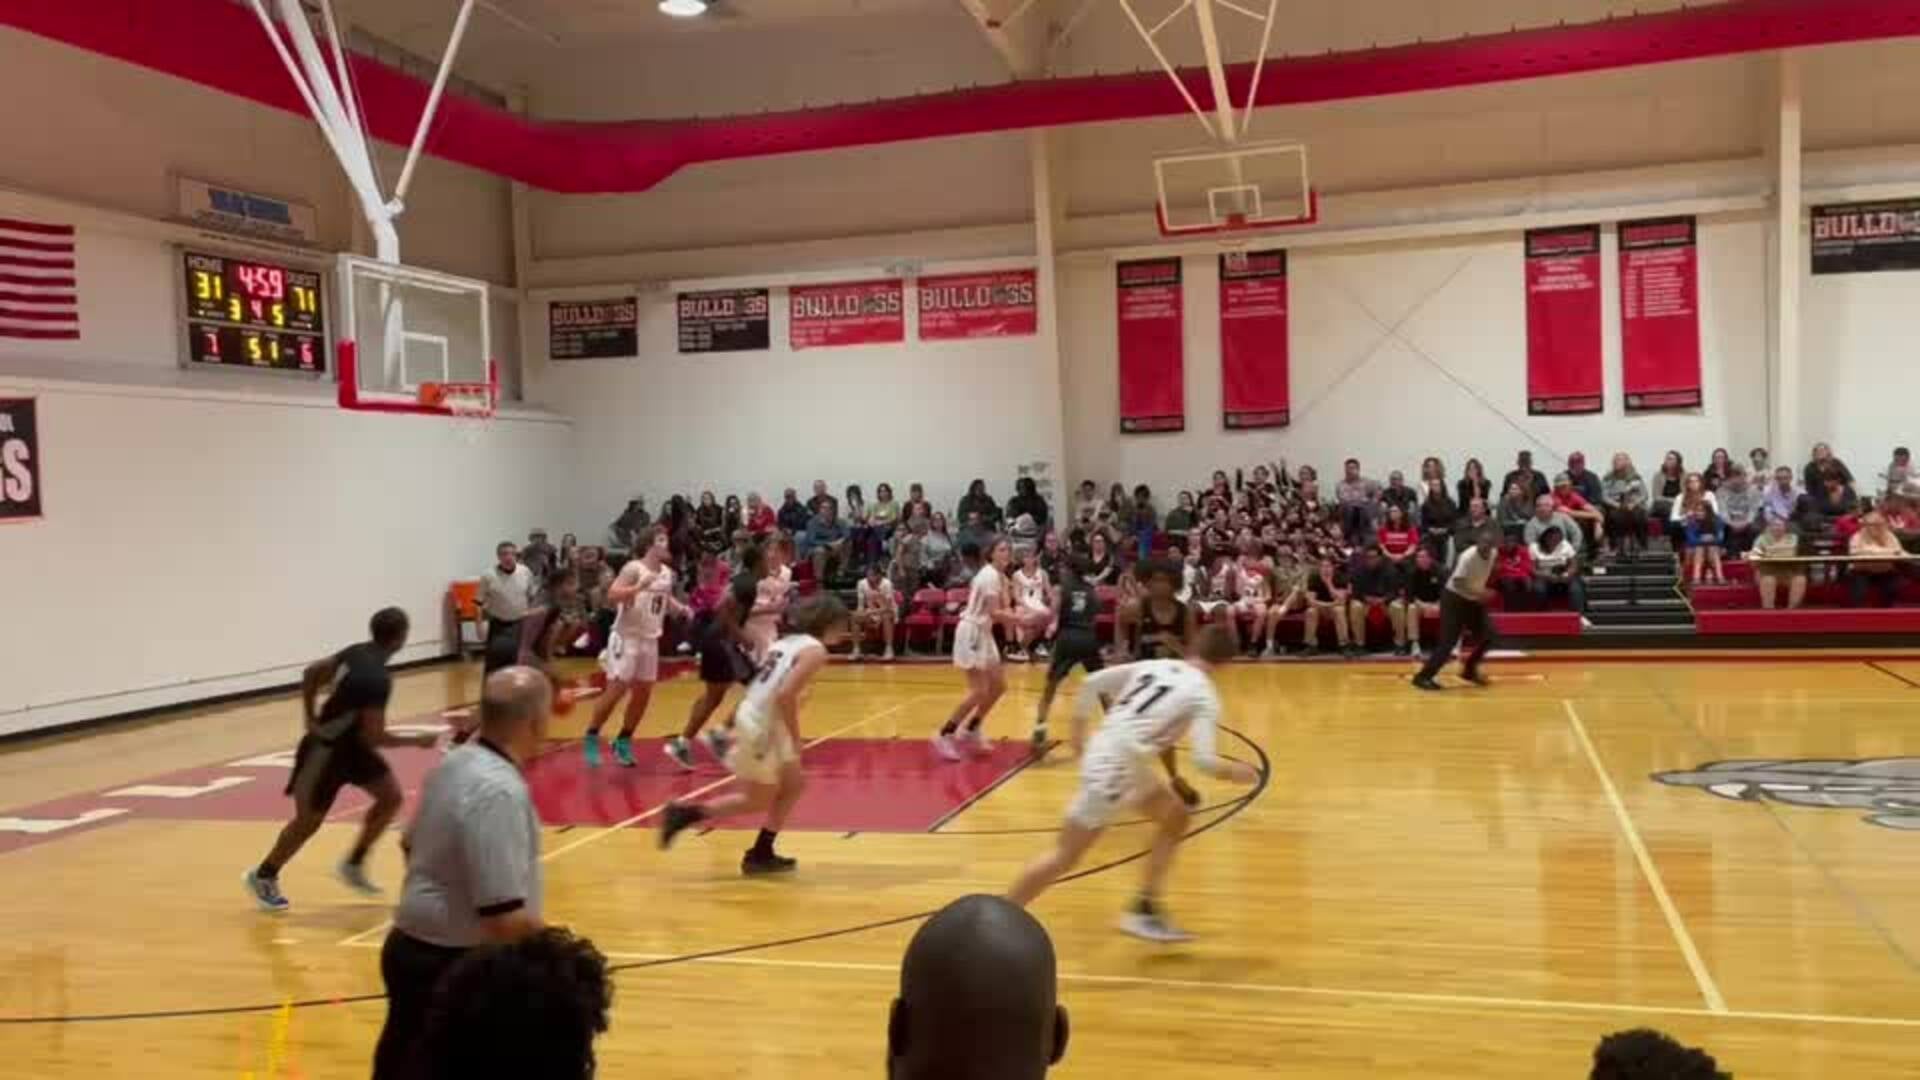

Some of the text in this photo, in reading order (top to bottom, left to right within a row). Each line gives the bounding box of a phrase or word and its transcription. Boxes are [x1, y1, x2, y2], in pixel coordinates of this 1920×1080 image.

[195, 272, 221, 299] 31
[229, 298, 284, 325] 3 4 5
[293, 287, 315, 313] 71
